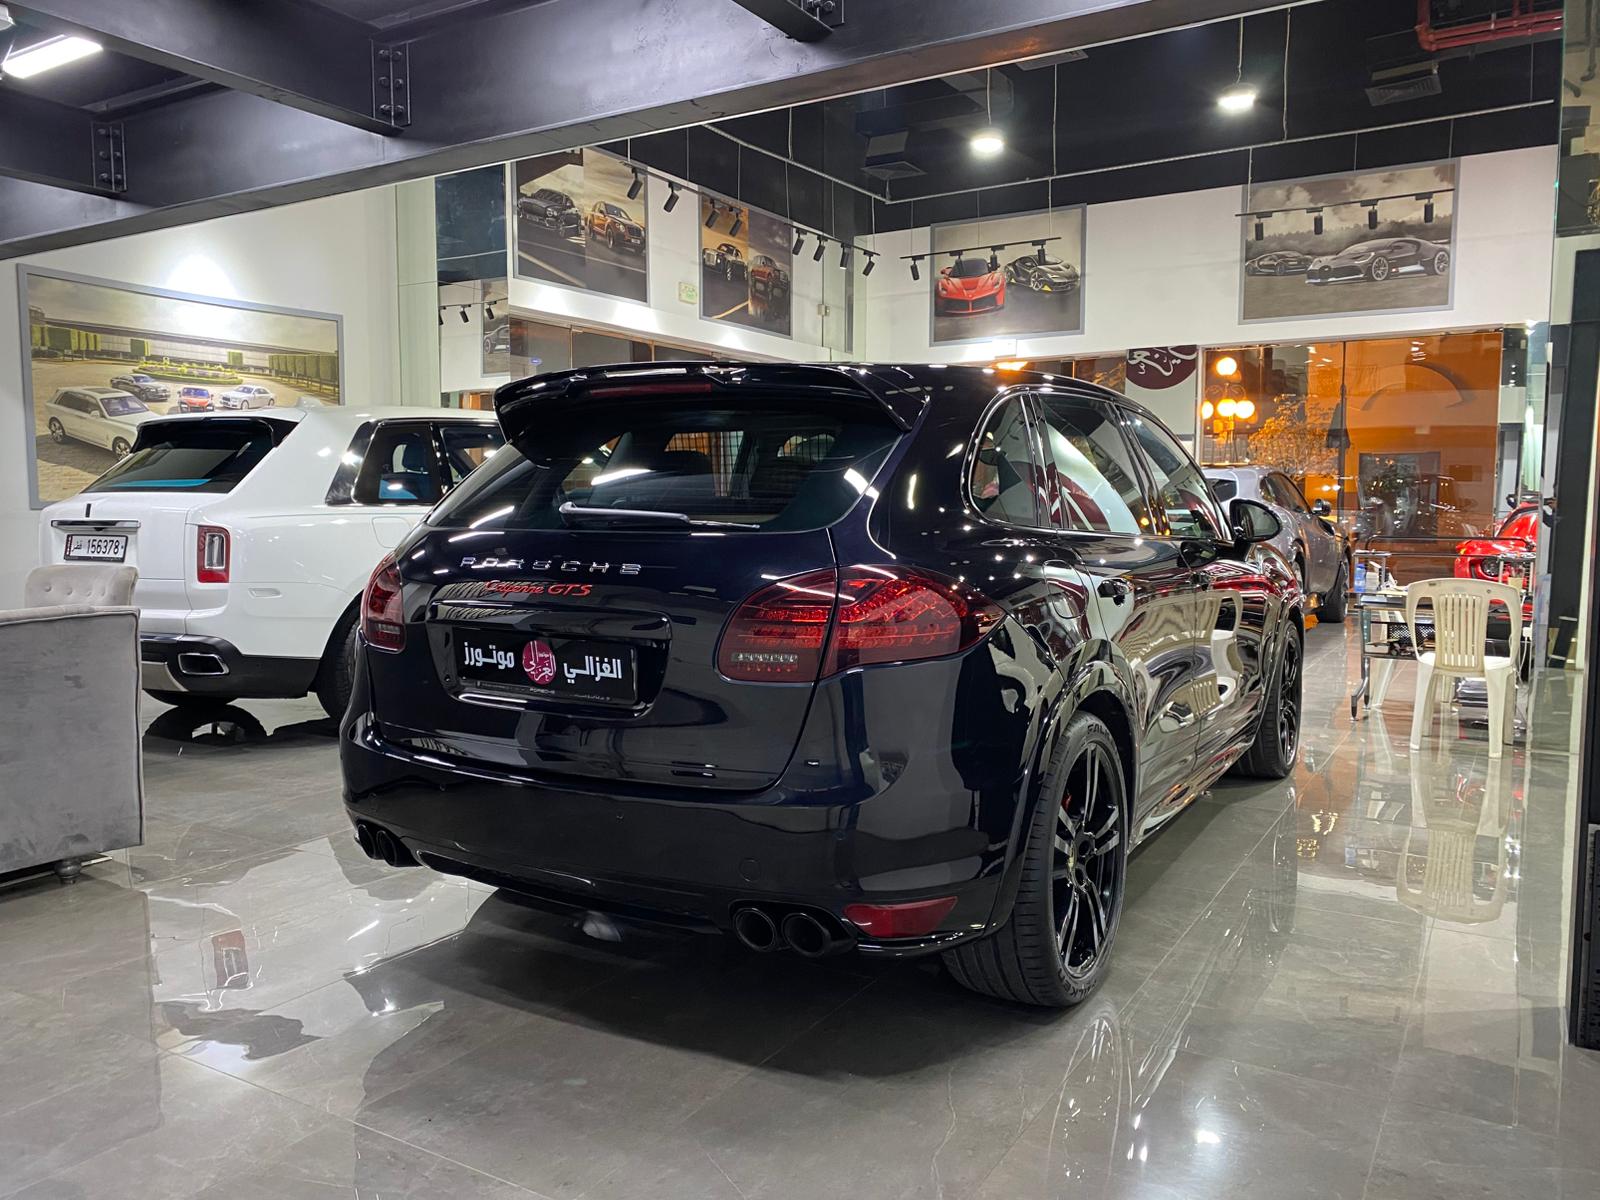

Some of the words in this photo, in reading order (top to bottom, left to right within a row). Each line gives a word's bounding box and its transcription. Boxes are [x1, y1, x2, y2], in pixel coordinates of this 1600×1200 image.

[86, 538, 121, 555] 156378
[459, 556, 642, 575] PORSCHE
[484, 579, 545, 598] Cayenne
[547, 583, 593, 597] GTS
[463, 641, 515, 671] موتورز
[562, 655, 623, 684] الغزالي
